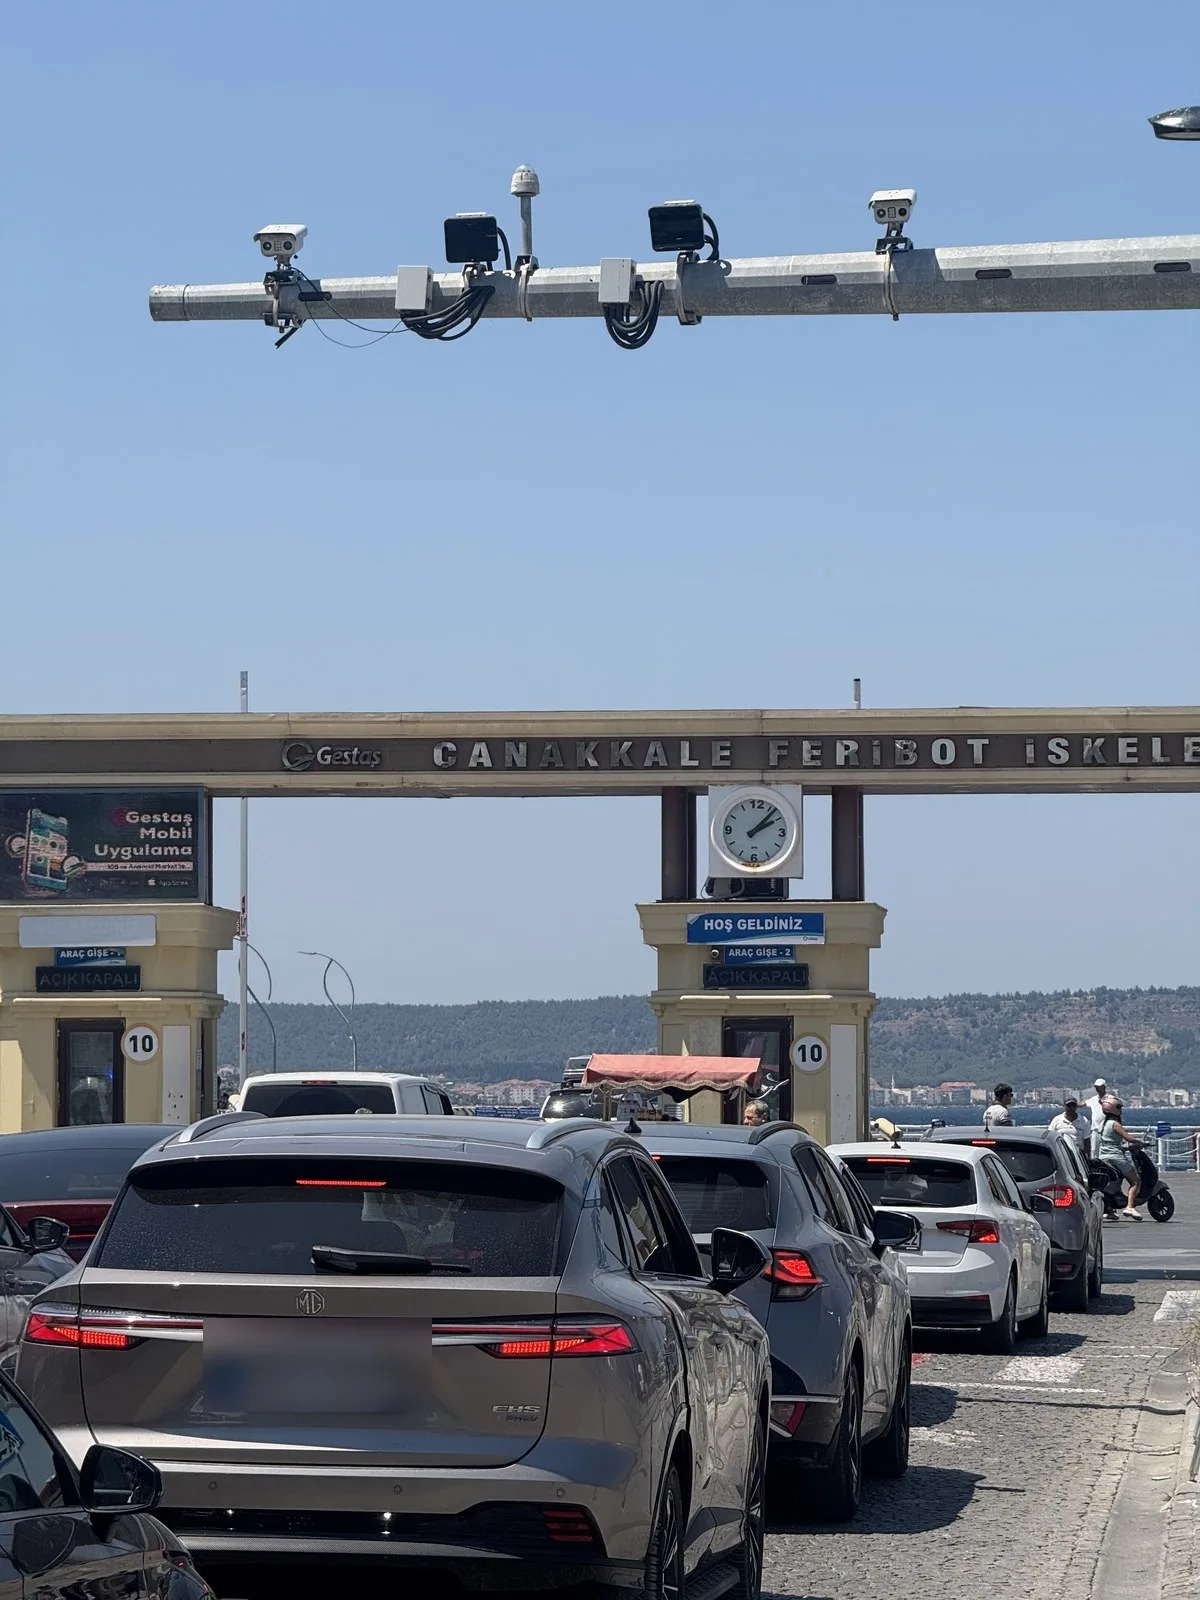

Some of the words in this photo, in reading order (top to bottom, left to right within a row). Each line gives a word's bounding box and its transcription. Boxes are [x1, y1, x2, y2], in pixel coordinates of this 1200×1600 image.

[317, 746, 381, 768] Gestaş
[768, 738, 990, 766] FERİBOT
[750, 800, 765, 809] 12
[125, 811, 193, 827] Gestaş
[140, 827, 193, 839] Mobil
[725, 825, 732, 834] 9
[778, 828, 786, 837] 3
[94, 843, 193, 860] Uygulama
[751, 854, 757, 862] 6
[704, 918, 733, 933] HOŞ
[737, 916, 803, 930] GELDİNİZ
[60, 949, 85, 959] ARAÇ
[87, 948, 109, 958] GİŞE
[728, 949, 753, 958] ARAÇ
[756, 947, 778, 958] GİŞE
[785, 948, 791, 956] 2
[39, 972, 78, 988] AÇIK
[81, 972, 138, 986] KAPALI
[749, 970, 806, 983] KAPALI
[129, 1034, 154, 1053] 10
[797, 1044, 822, 1062] 10
[298, 1291, 322, 1314] MG
[492, 1405, 541, 1413] EHS
